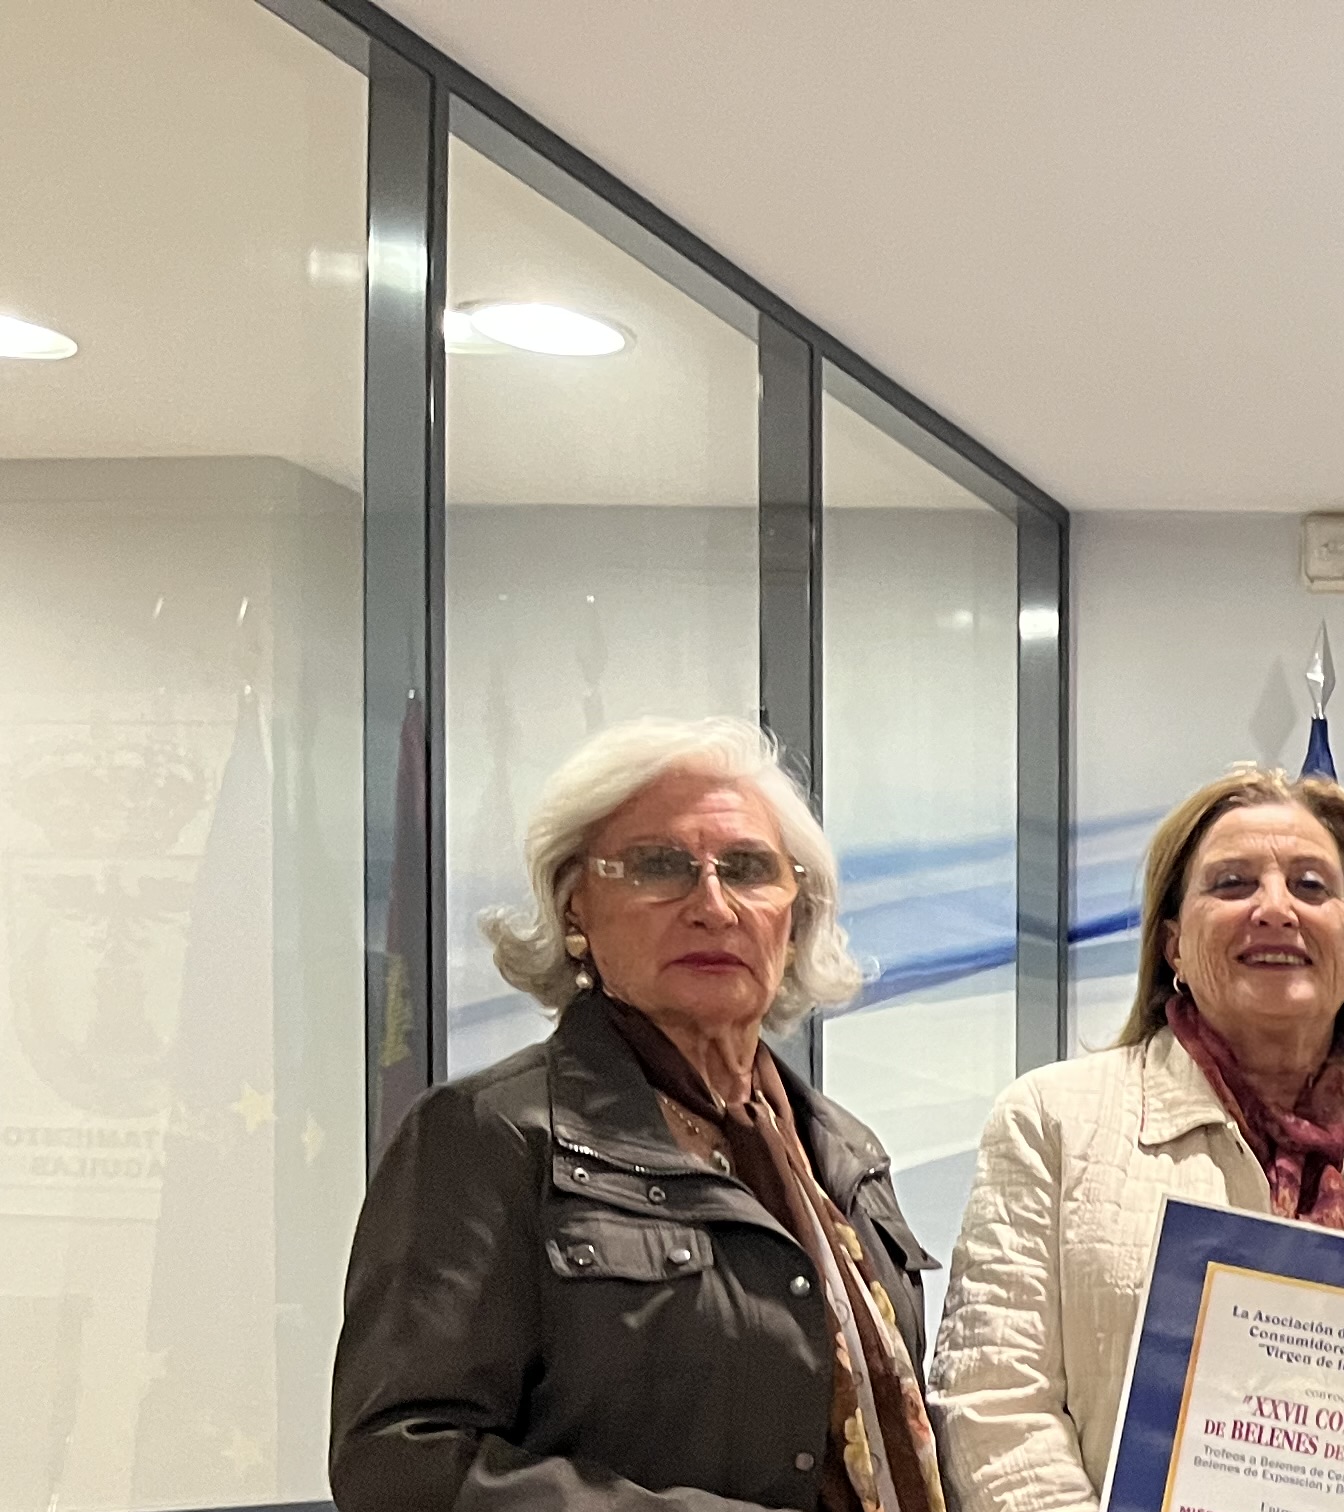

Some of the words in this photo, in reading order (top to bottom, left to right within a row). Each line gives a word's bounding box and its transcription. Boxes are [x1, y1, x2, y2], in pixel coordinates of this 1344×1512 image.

[1232, 1305, 1249, 1320] La
[1253, 1309, 1334, 1336] Asociación
[1258, 1343, 1312, 1366] "Virgen
[1316, 1355, 1333, 1369] de
[1242, 1394, 1309, 1426] "XXVII
[1204, 1418, 1226, 1437] DE
[1230, 1419, 1319, 1455] BELENES
[1323, 1442, 1344, 1461] DE
